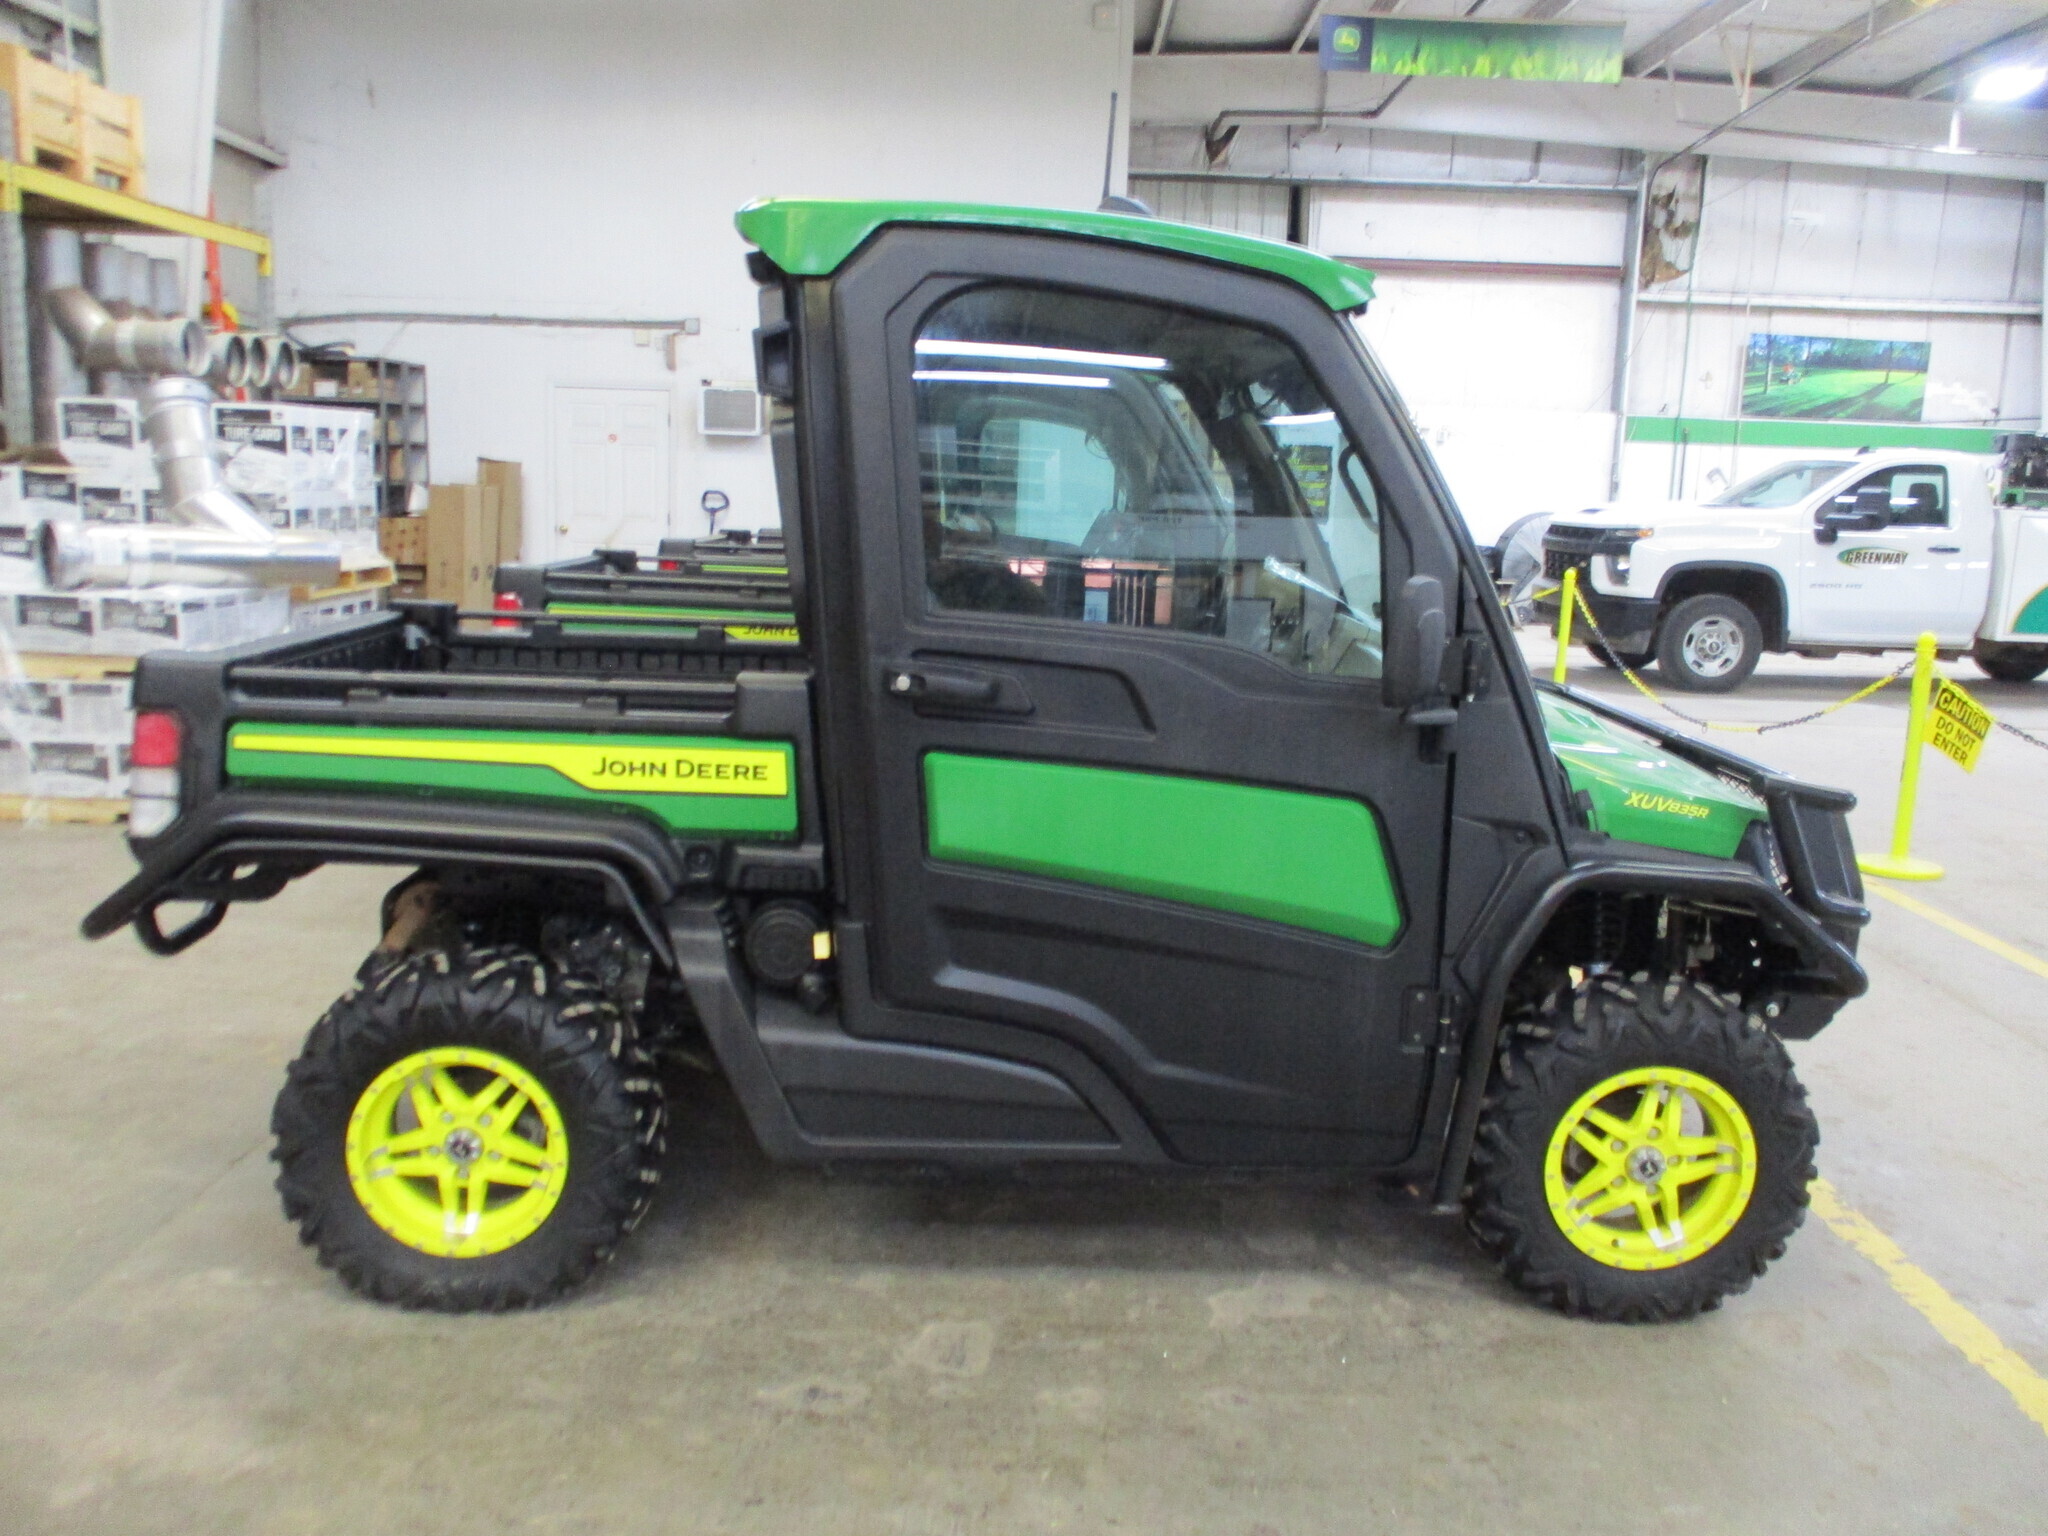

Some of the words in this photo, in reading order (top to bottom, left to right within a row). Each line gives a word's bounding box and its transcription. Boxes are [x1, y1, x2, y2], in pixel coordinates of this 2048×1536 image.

[1845, 550, 1909, 566] GREENWAY
[1938, 691, 1989, 737] CAUTION
[1936, 716, 1954, 735] DO
[1955, 729, 1976, 750] NOT
[1933, 733, 1968, 766] ENTER
[592, 757, 667, 778] JOHN
[676, 759, 769, 781] DEERE
[1624, 790, 1711, 819] XUV835R
